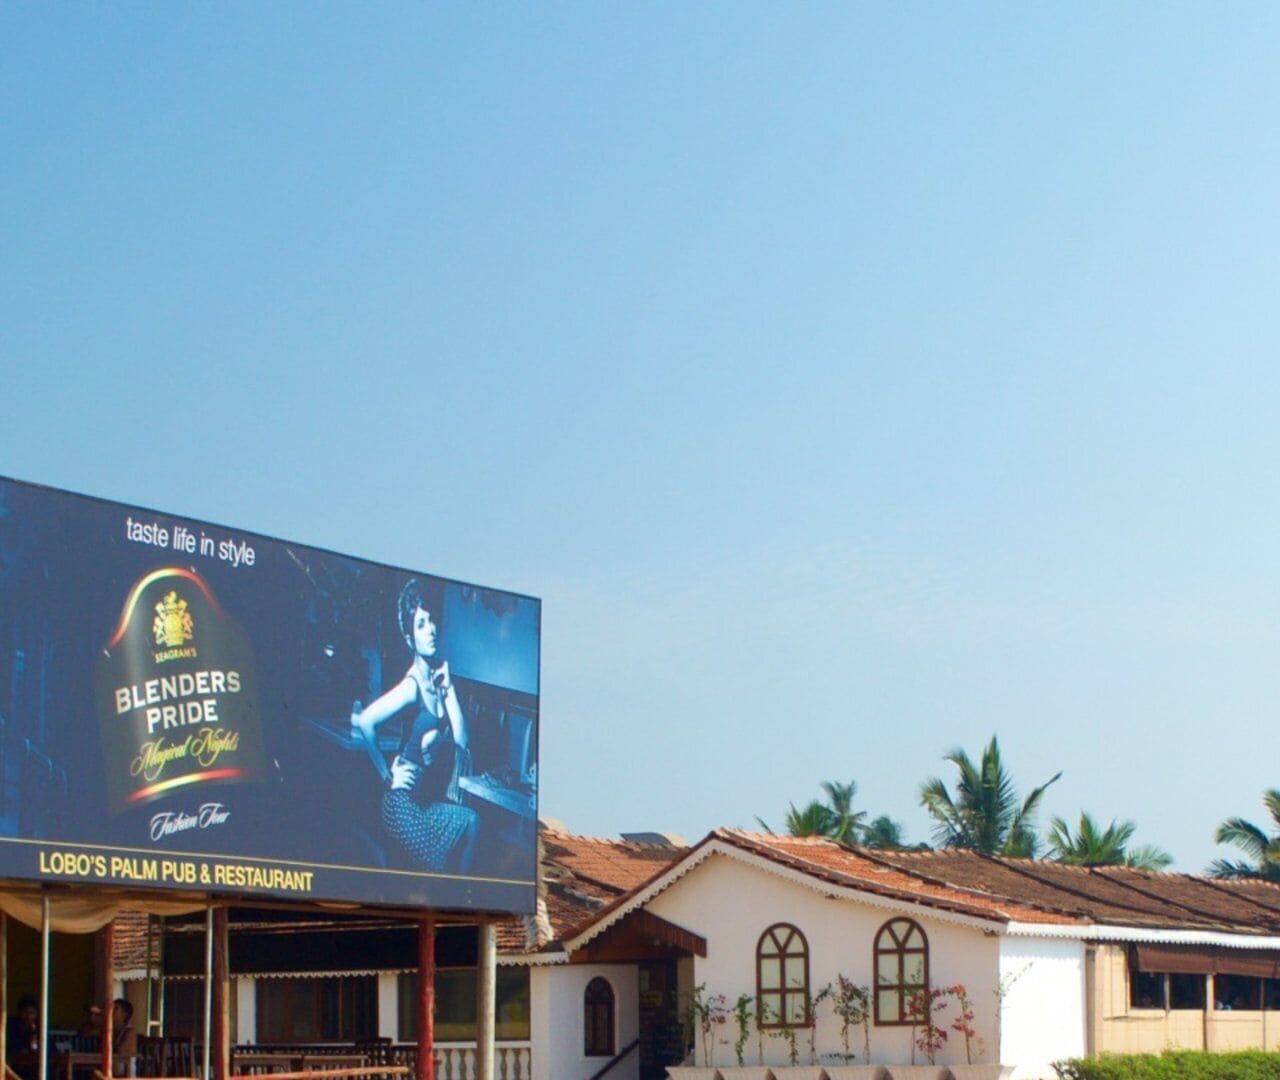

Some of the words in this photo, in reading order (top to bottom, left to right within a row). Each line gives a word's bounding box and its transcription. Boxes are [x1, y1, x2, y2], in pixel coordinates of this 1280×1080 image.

[126, 516, 169, 548] taste
[173, 526, 196, 553] life
[200, 532, 214, 557] in
[218, 541, 256, 567] style
[114, 671, 241, 714] BLENDERS
[146, 699, 218, 734] PRIDE
[39, 851, 107, 877] LOBO'S
[111, 856, 158, 881] PALM
[162, 861, 196, 884] PUB
[200, 865, 211, 885] &
[214, 867, 314, 891] RESTAURANT
